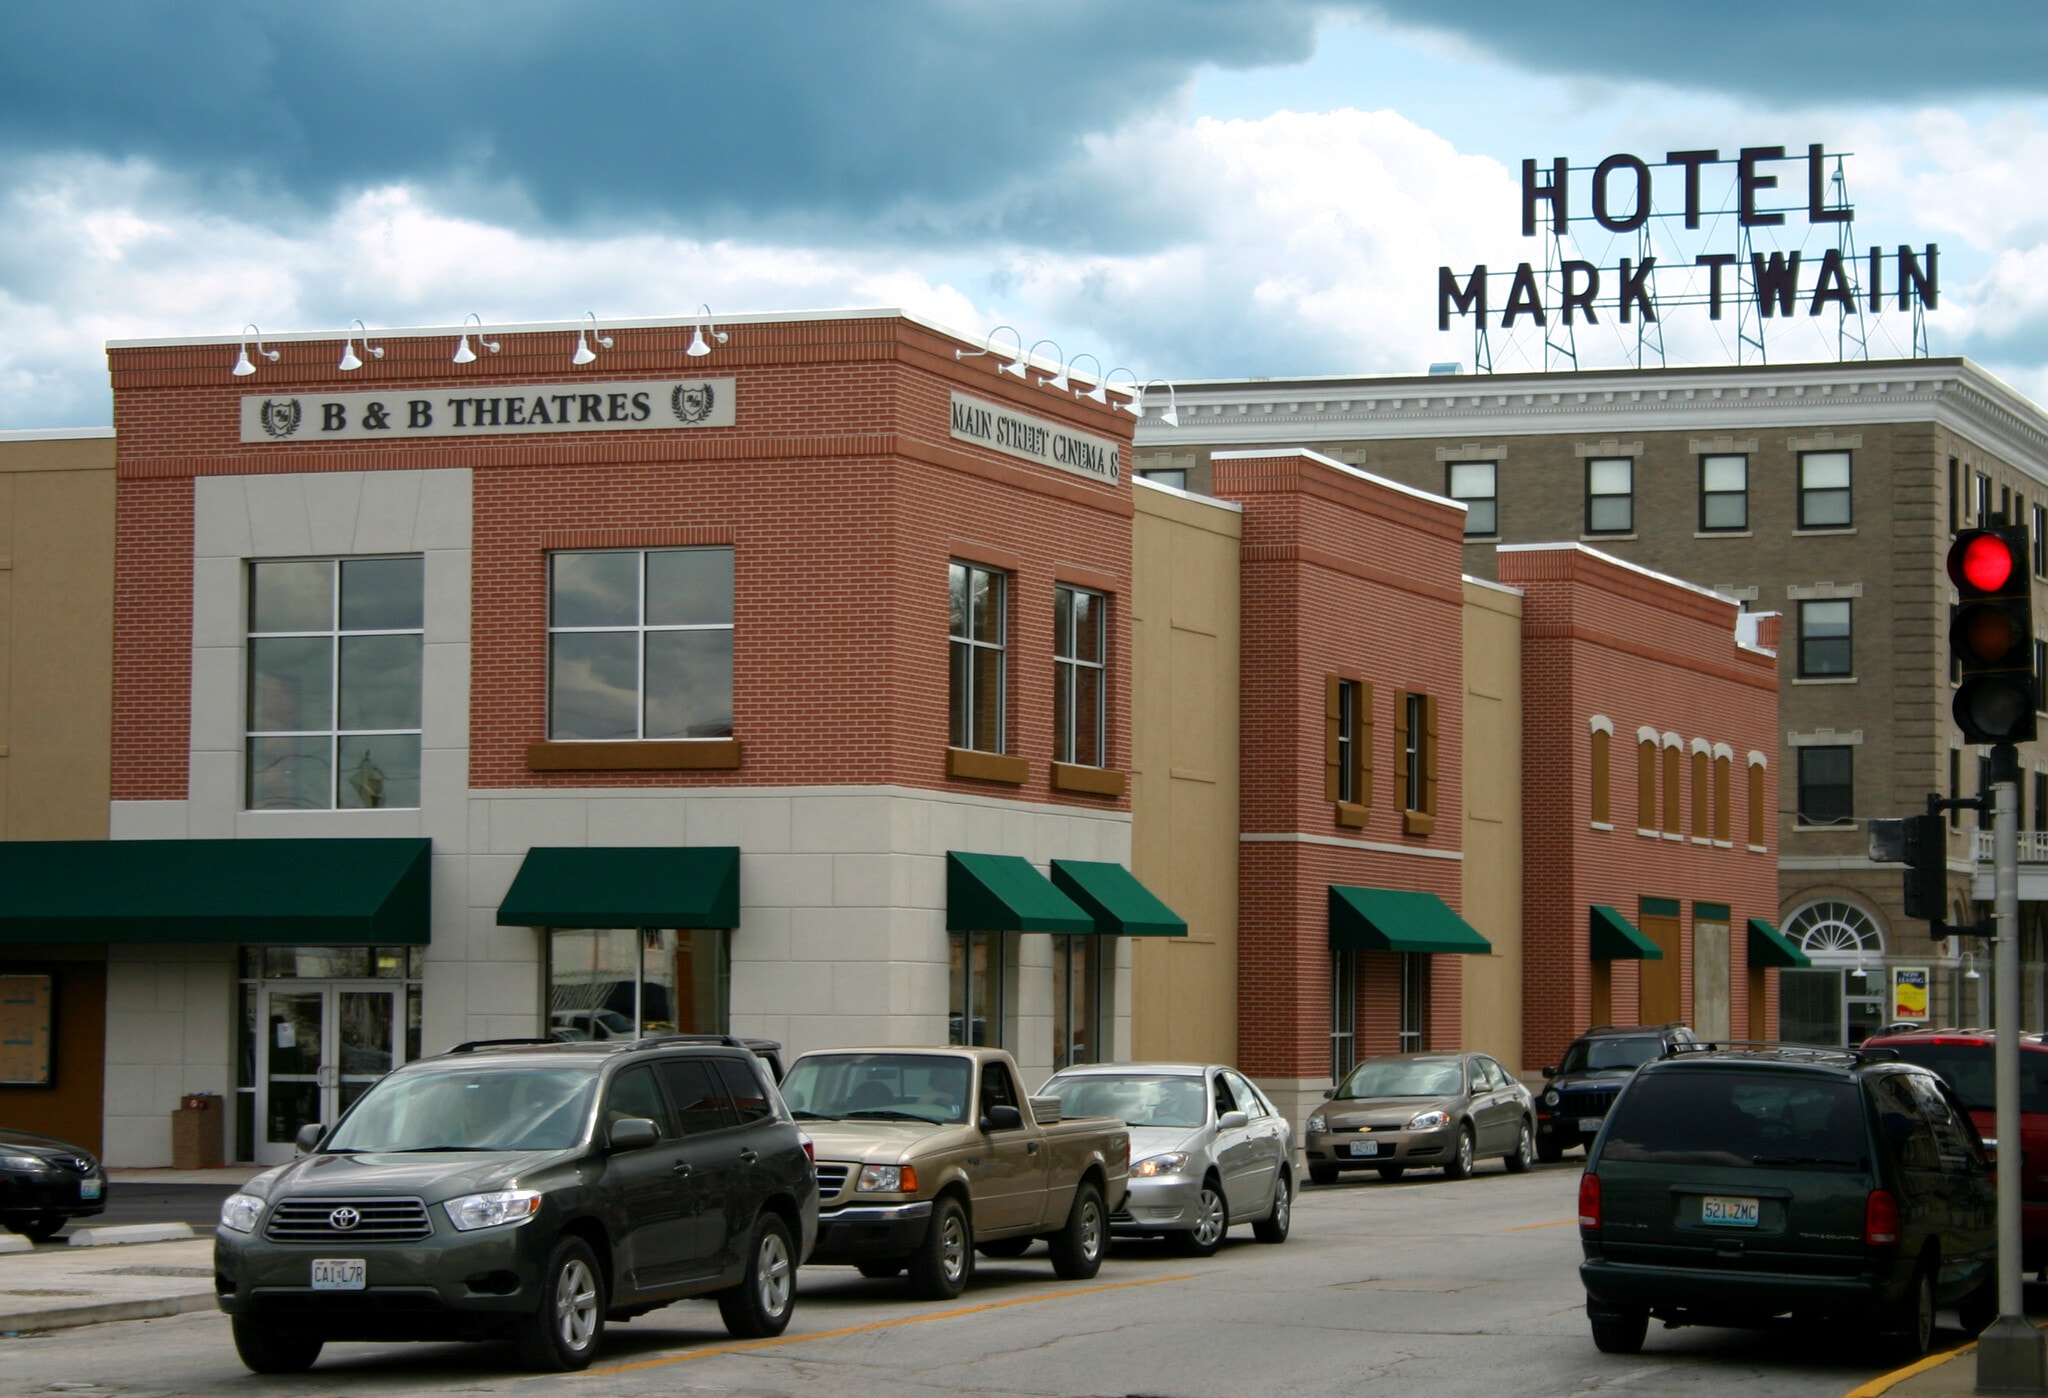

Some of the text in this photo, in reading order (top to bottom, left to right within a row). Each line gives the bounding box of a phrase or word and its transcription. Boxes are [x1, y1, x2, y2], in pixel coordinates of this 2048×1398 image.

[1522, 143, 1855, 236] HOTEL
[1438, 243, 1938, 331] MARK TWAIN
[321, 402, 347, 432] B
[362, 401, 391, 430] &
[408, 400, 433, 429] B
[448, 392, 651, 427] THEATRES
[952, 401, 992, 440] MAIN
[997, 416, 1049, 457] STREET
[1053, 433, 1106, 475] CINEMA
